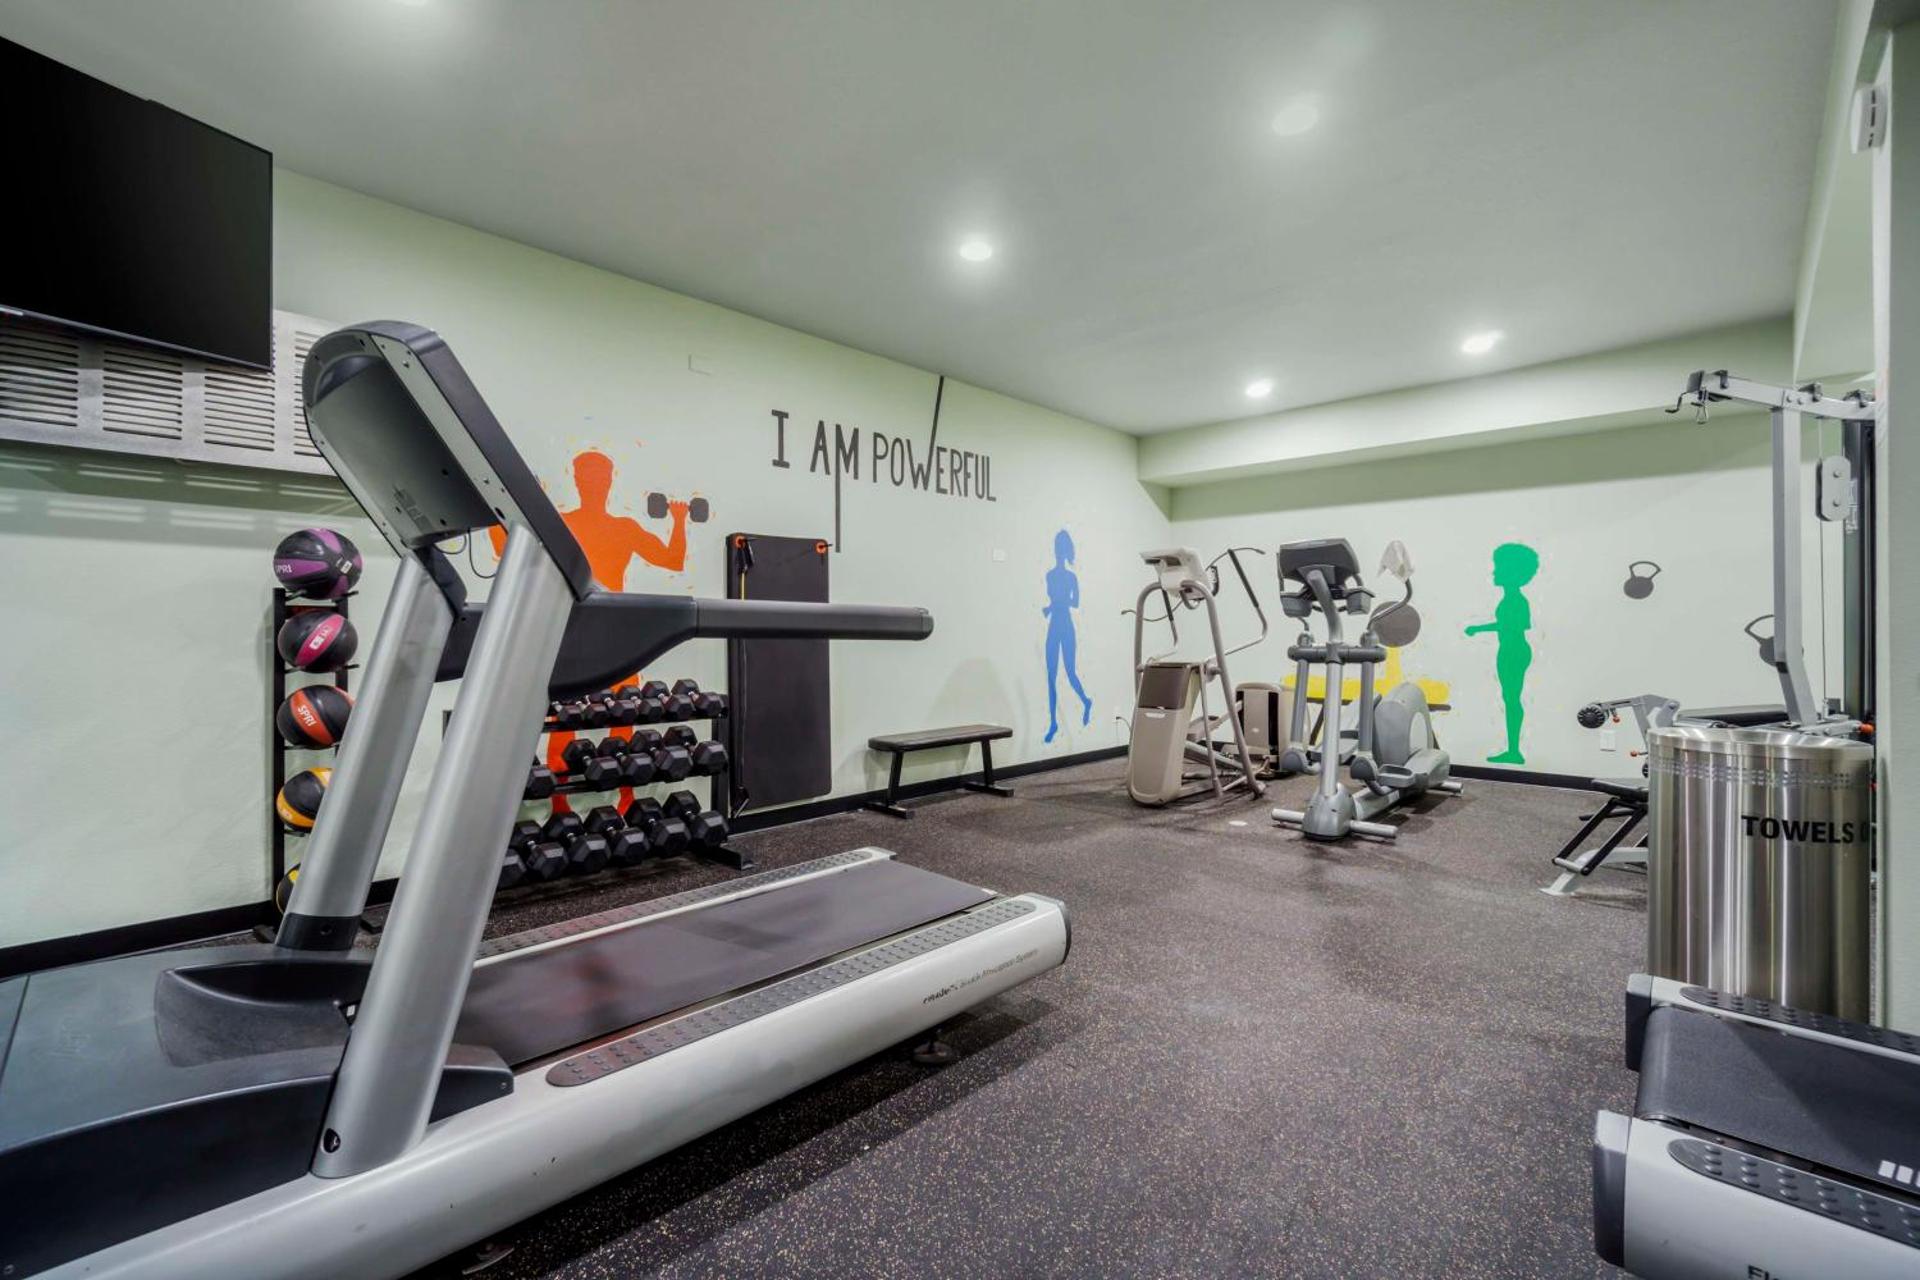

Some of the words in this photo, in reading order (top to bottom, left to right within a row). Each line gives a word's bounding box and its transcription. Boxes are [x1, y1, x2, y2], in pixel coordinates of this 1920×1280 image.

[771, 409, 790, 469] I
[872, 375, 997, 502] POWERFUL
[298, 704, 317, 727] SPRI
[1741, 815, 1854, 844] TOWELS
